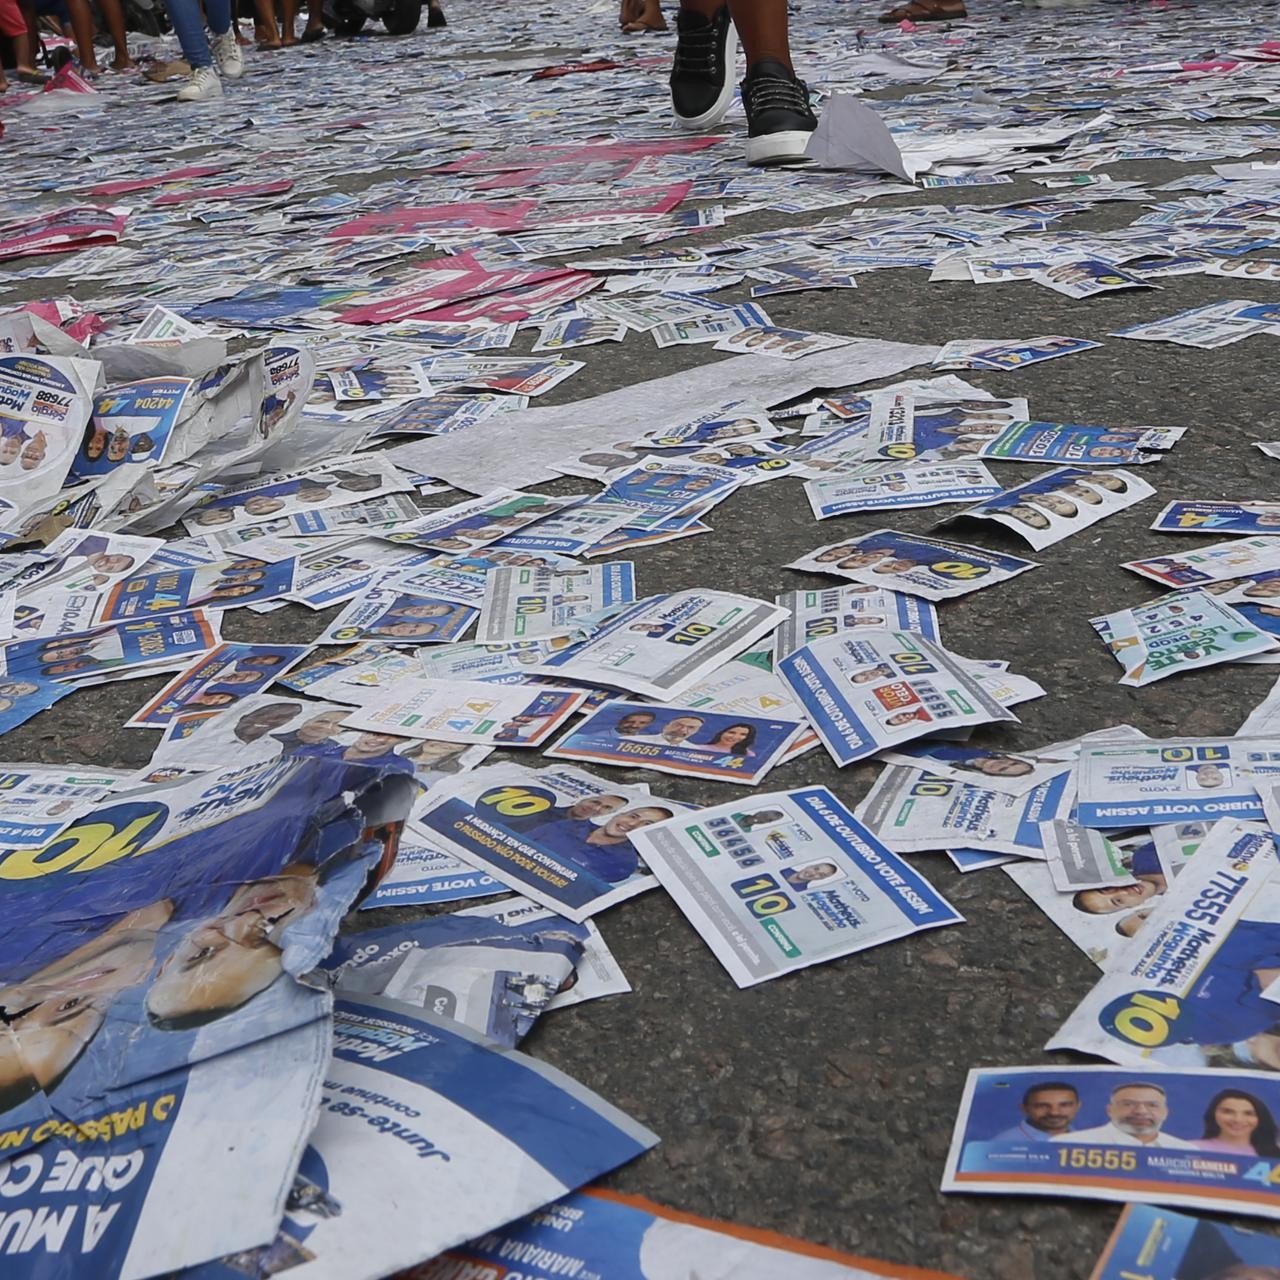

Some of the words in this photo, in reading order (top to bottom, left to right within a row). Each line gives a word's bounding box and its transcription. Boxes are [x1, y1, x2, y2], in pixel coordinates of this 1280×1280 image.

[36, 391, 73, 408] 77688
[135, 398, 175, 409] 44204
[932, 562, 988, 578] 10
[669, 623, 718, 645] 10
[894, 653, 931, 673] 10
[1162, 745, 1229, 762] 10
[480, 786, 552, 817] 10
[1095, 804, 1151, 818] ASSIM
[1153, 803, 1201, 815] VOTE
[472, 817, 505, 841] MUDANÇA
[501, 834, 518, 850] TEM
[517, 841, 534, 857] QUE
[532, 849, 578, 882] CONTINUAR.
[692, 829, 716, 854] CONFIRMA
[707, 816, 762, 870] 36456
[803, 794, 824, 812] DIA
[837, 825, 882, 866] OUTUBRO
[870, 859, 902, 889] VOTE
[897, 883, 934, 917] ASSIM
[376, 884, 430, 901] ASSIM
[430, 877, 477, 897] VOTE
[532, 865, 570, 889] VOLTAR!
[738, 878, 788, 915] 10
[805, 891, 849, 931] Waguinho
[820, 888, 861, 931] Matheus.
[1183, 870, 1250, 923] 77555
[765, 922, 793, 955] CONFIRMA
[1144, 921, 1192, 982] Waguinho
[1157, 923, 1216, 988] Matheus.
[1114, 992, 1182, 1047] 10
[150, 1095, 176, 1121] O
[342, 1082, 421, 1118] continue
[328, 1100, 451, 1162] Junte-se
[48, 1147, 145, 1192] QUE
[1056, 1148, 1138, 1172] 15555
[78, 1200, 122, 1254] A
[502, 1239, 587, 1276] MARIANA
